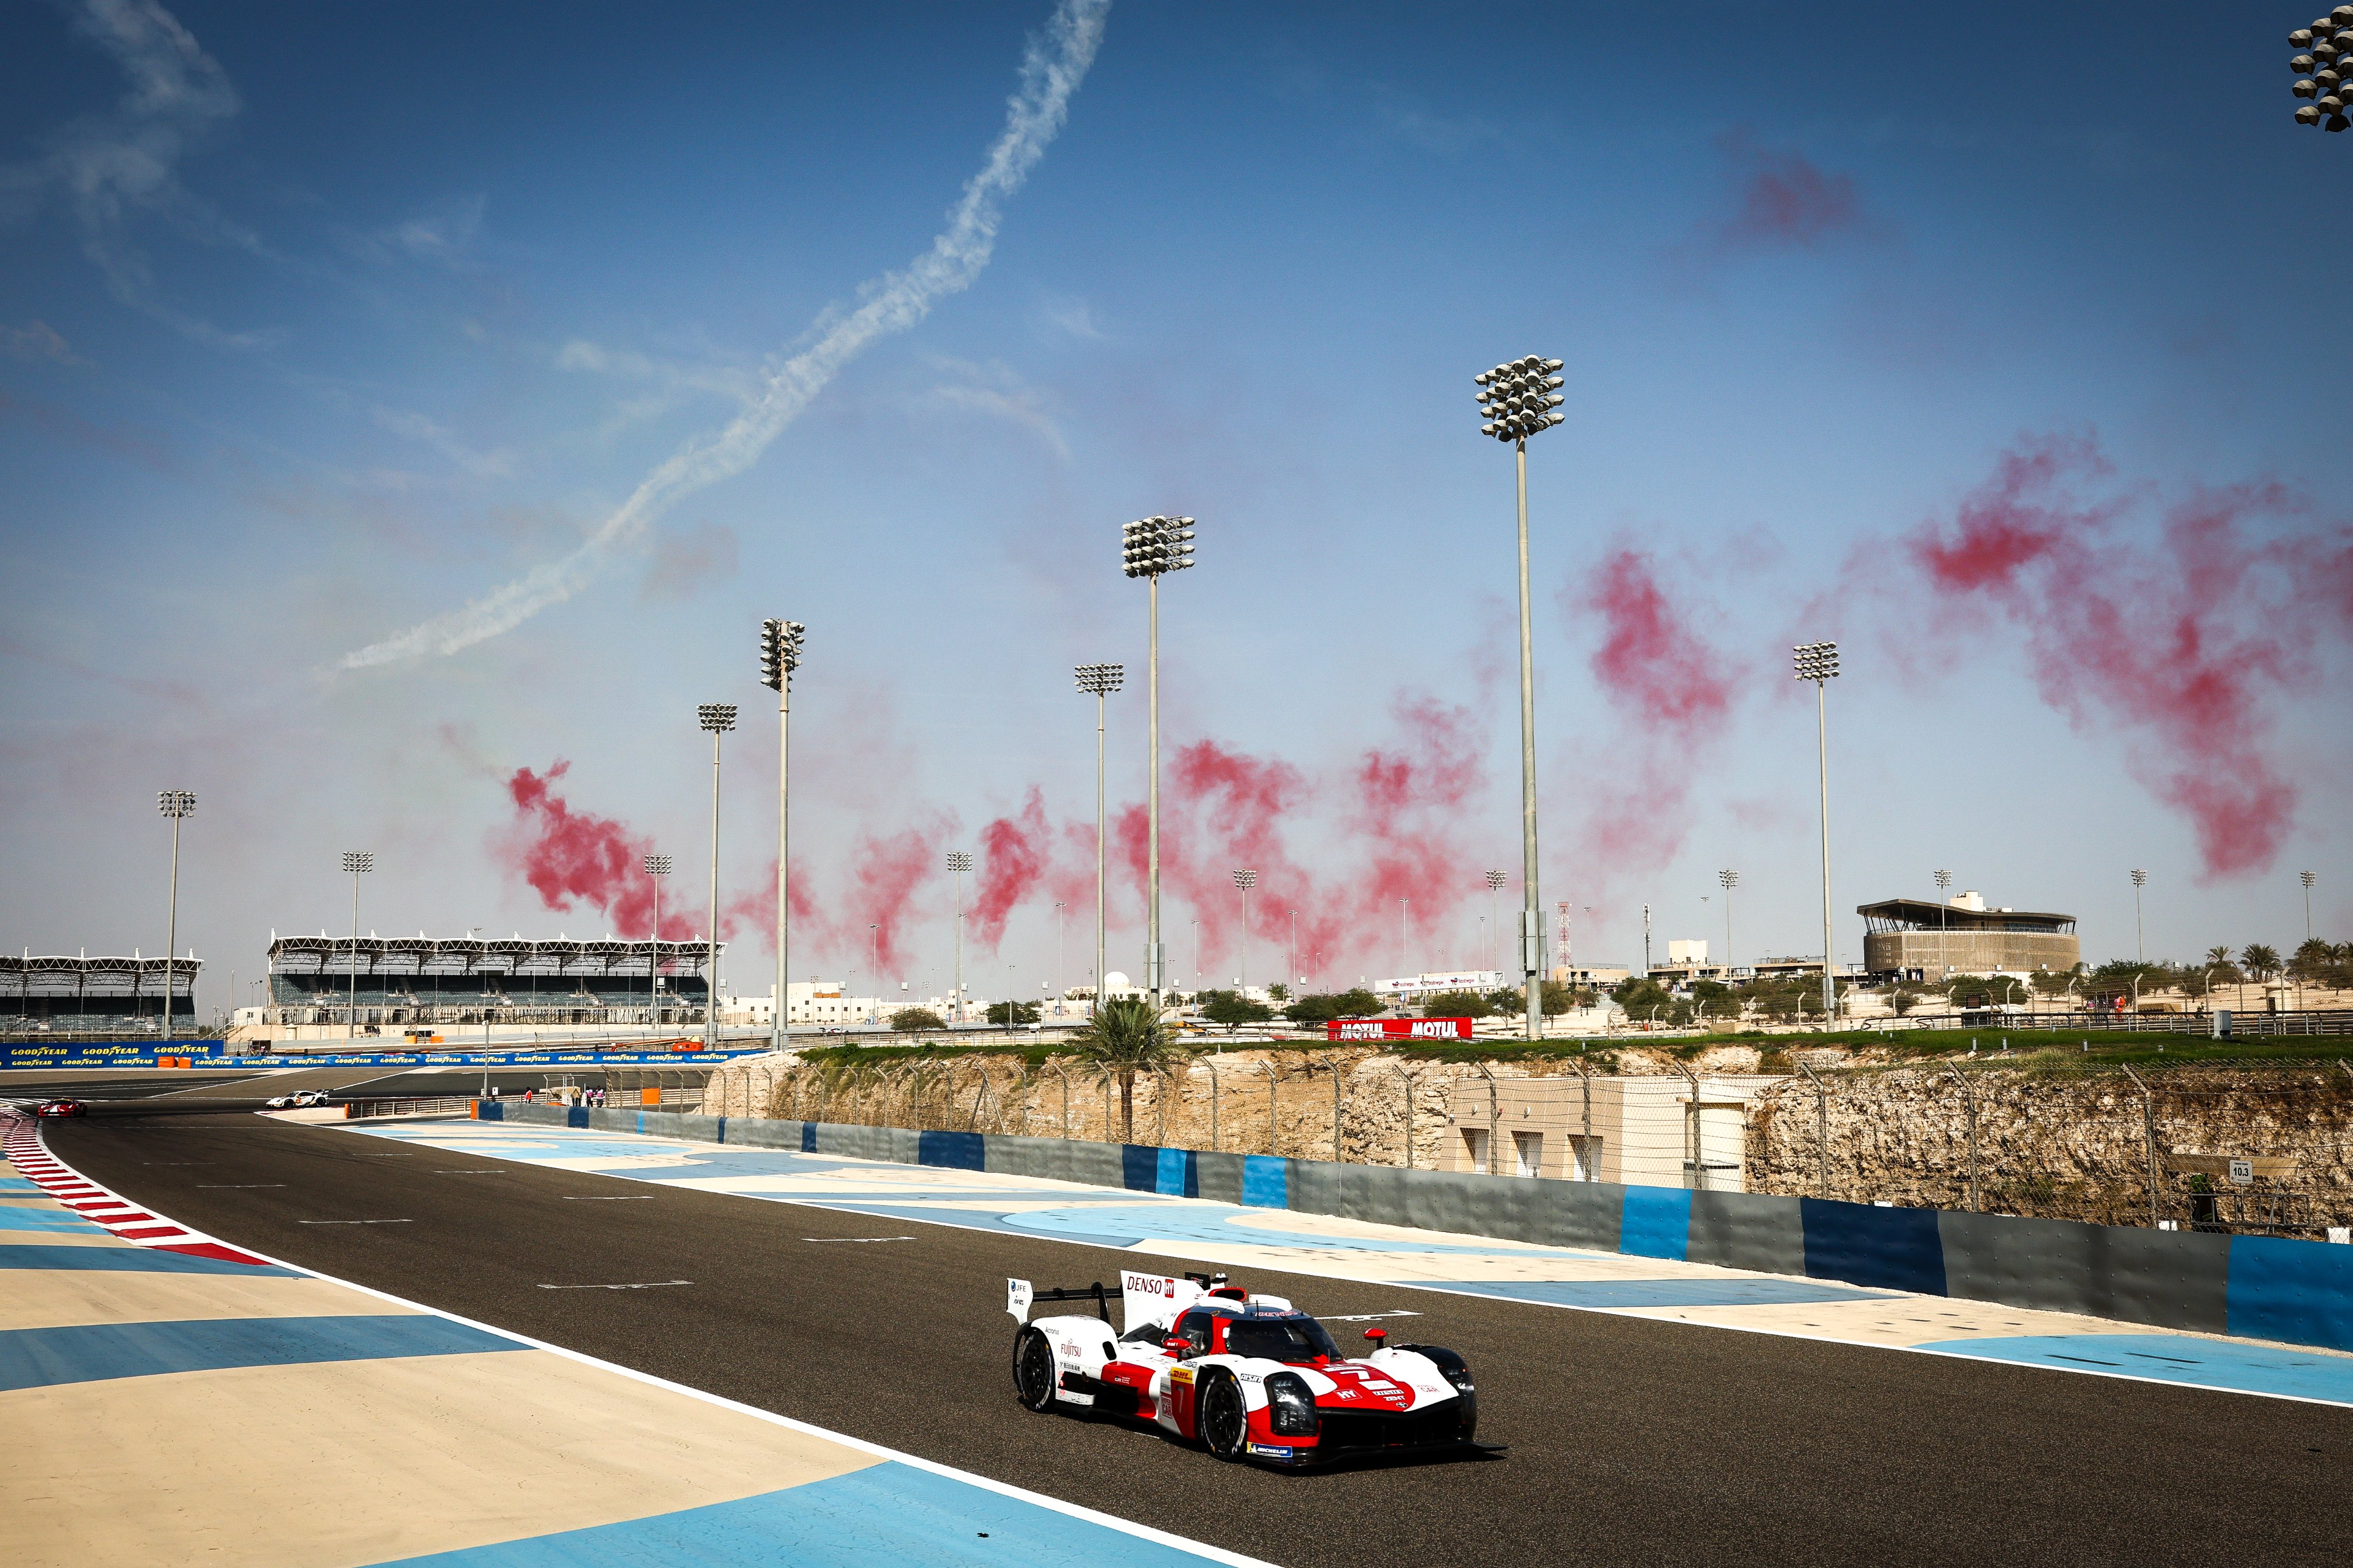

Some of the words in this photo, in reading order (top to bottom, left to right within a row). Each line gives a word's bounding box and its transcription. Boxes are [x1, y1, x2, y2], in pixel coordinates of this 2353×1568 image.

[1340, 1023, 1385, 1038] MOTUL
[1410, 1021, 1459, 1037] MOTUL
[11, 1047, 68, 1056] GOODYEAR
[82, 1046, 139, 1056] GOODYEAR
[153, 1044, 209, 1055] GOODYEAR
[2234, 1167, 2248, 1176] 10.3
[1127, 1276, 1162, 1295] DENSO
[1165, 1283, 1174, 1295] HY
[1045, 1327, 1059, 1335] Acronis
[1061, 1343, 1082, 1358] FUJITSU
[1173, 1370, 1189, 1379] DHL
[1241, 1373, 1262, 1383] AISIN
[1340, 1370, 1371, 1380] 7
[1338, 1390, 1357, 1399] HY
